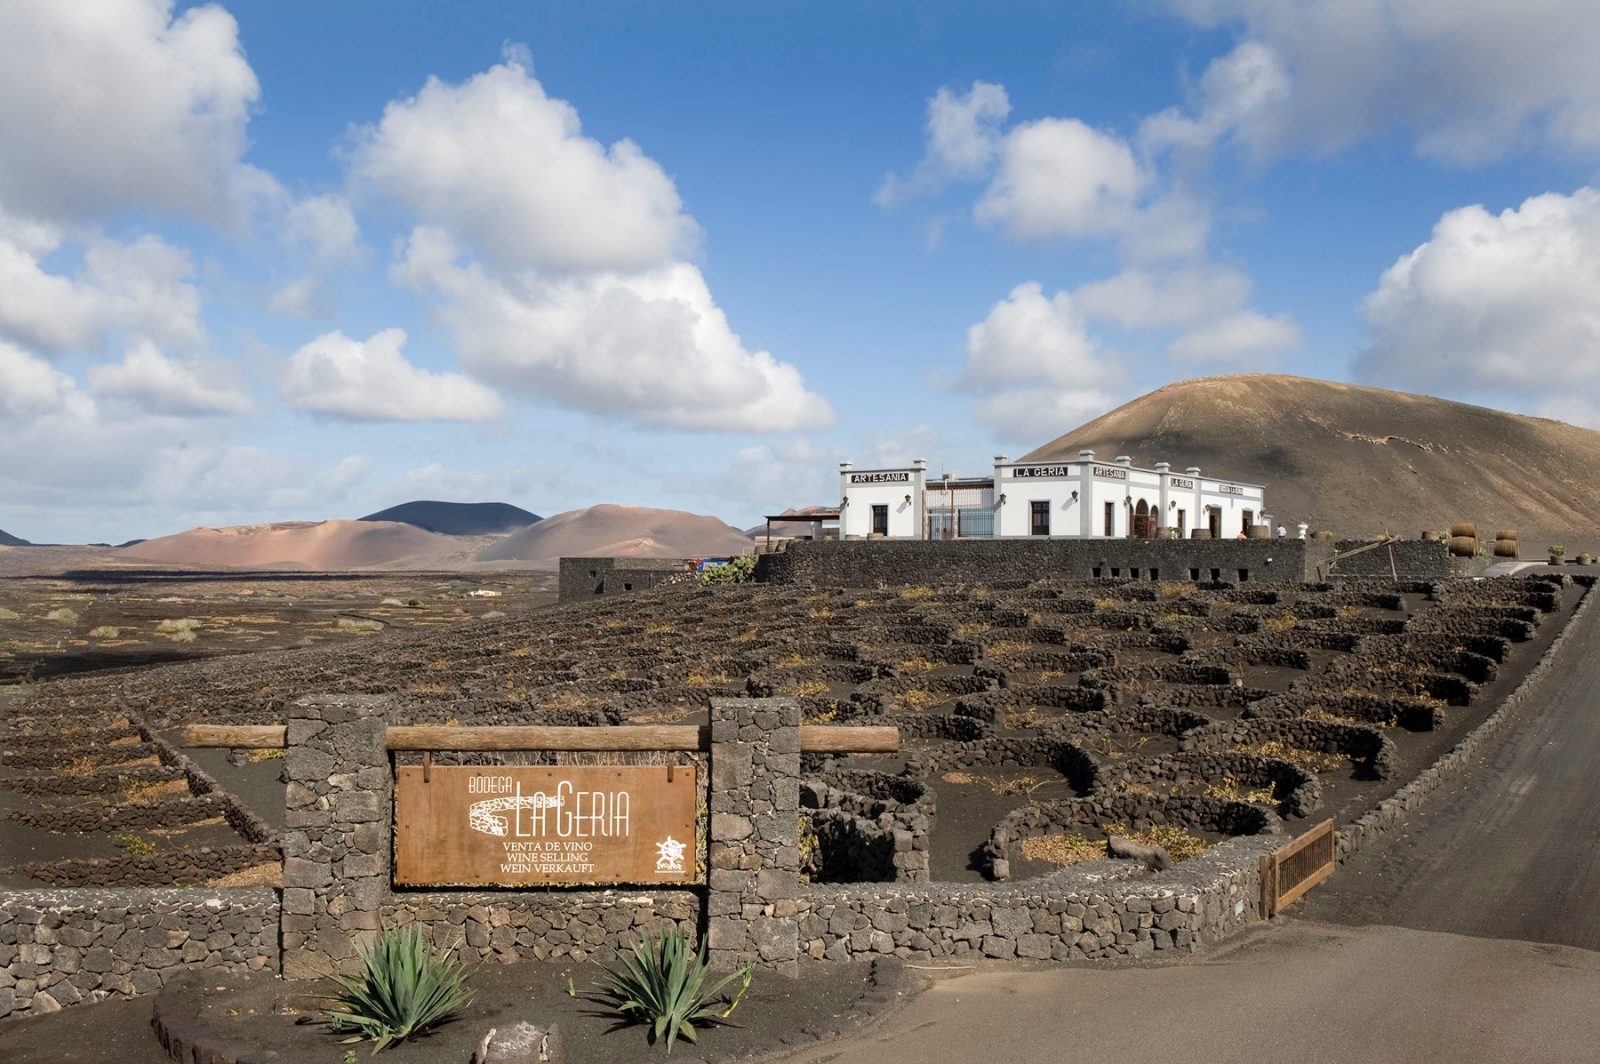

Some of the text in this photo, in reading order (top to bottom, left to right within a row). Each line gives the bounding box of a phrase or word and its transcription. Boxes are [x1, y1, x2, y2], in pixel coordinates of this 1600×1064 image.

[1015, 467, 1065, 477] LA GERIA
[854, 472, 907, 483] ARTESANIA
[468, 776, 513, 794] BODEGA
[516, 780, 630, 837] LA GERIA
[502, 842, 593, 852] VENTA DE VINO
[507, 853, 588, 862] WINE SELLING
[500, 863, 595, 873] WEIN VERKAUFT
